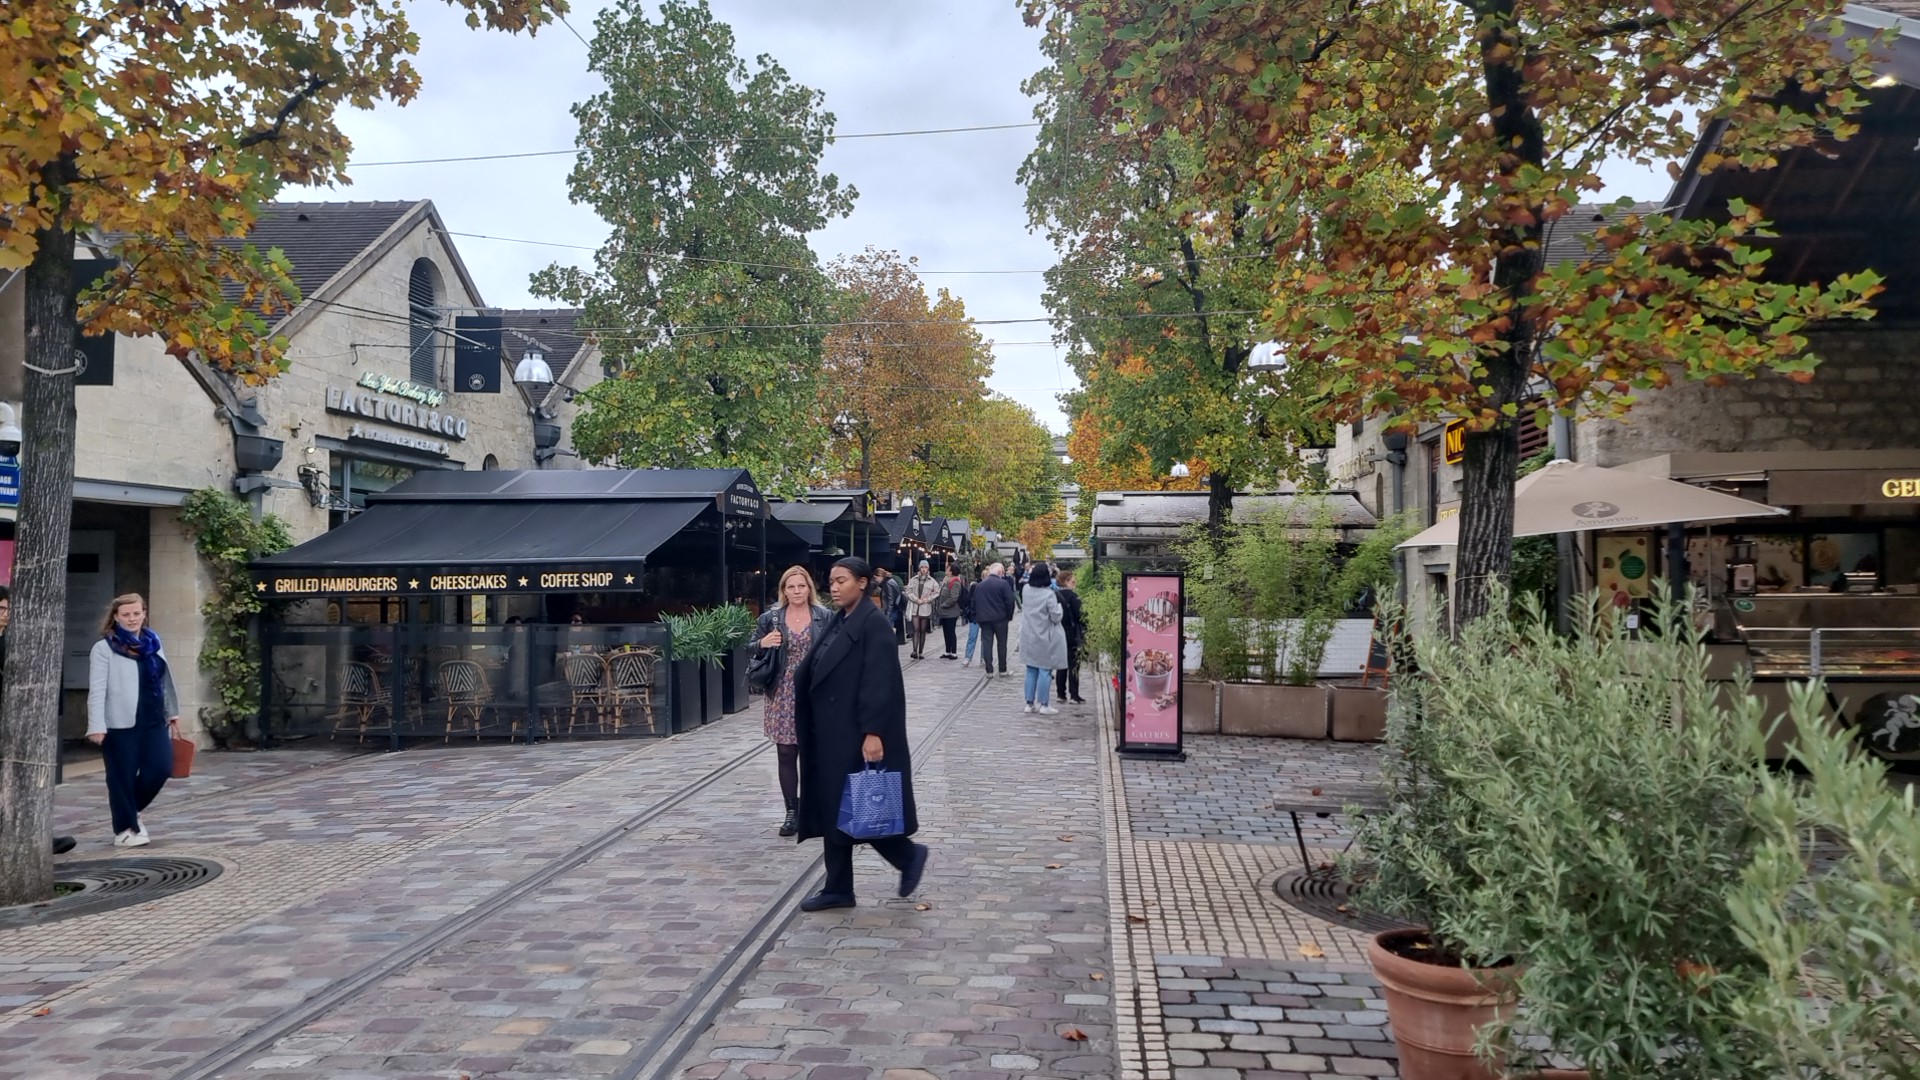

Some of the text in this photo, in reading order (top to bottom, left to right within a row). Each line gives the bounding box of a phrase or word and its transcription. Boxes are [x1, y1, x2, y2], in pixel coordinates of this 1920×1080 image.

[379, 375, 400, 393] York
[326, 384, 468, 438] FACTORY&CO
[275, 572, 614, 593] GRILLED HAMBURGERS CHEESECAKES COFFEE SHOP
